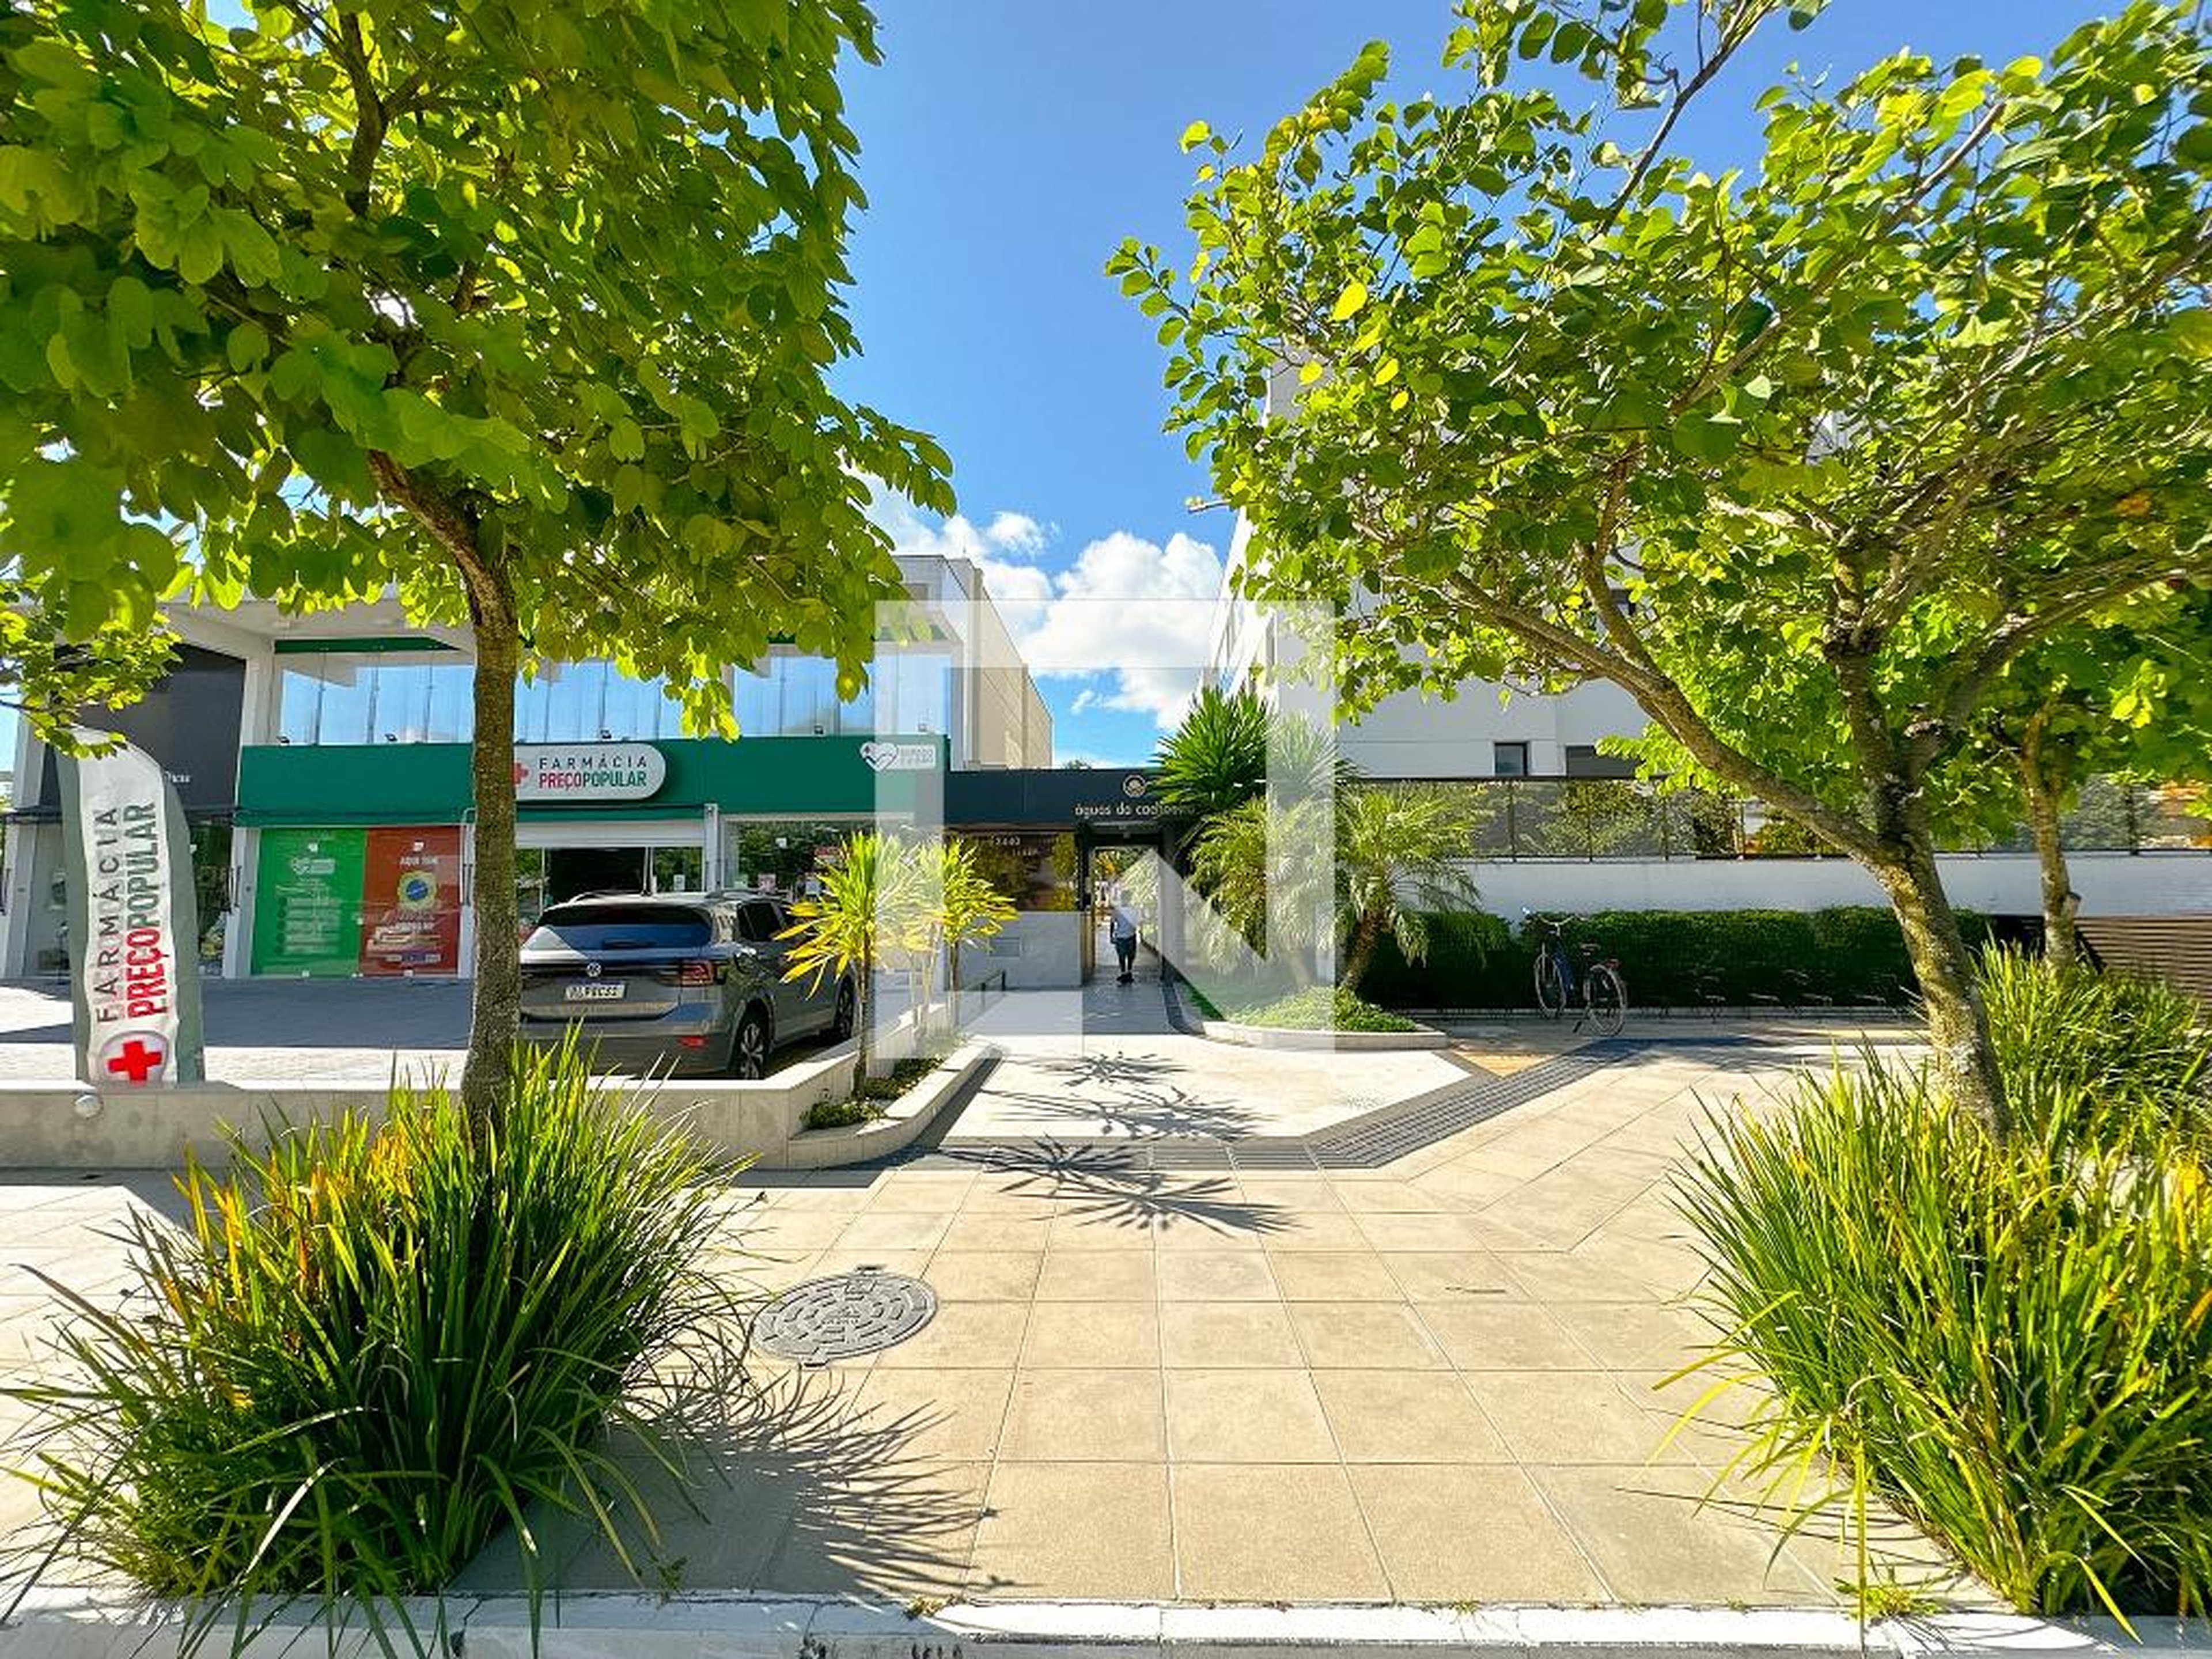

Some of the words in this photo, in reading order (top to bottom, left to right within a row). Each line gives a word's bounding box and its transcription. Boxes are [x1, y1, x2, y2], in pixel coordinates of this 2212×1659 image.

[539, 753, 647, 770] FARMÁCIA
[539, 771, 647, 791] PREÇOPOPULAR
[93, 808, 120, 1024] FARMÁCIA
[123, 801, 170, 1020] PREÇOPOPULAR
